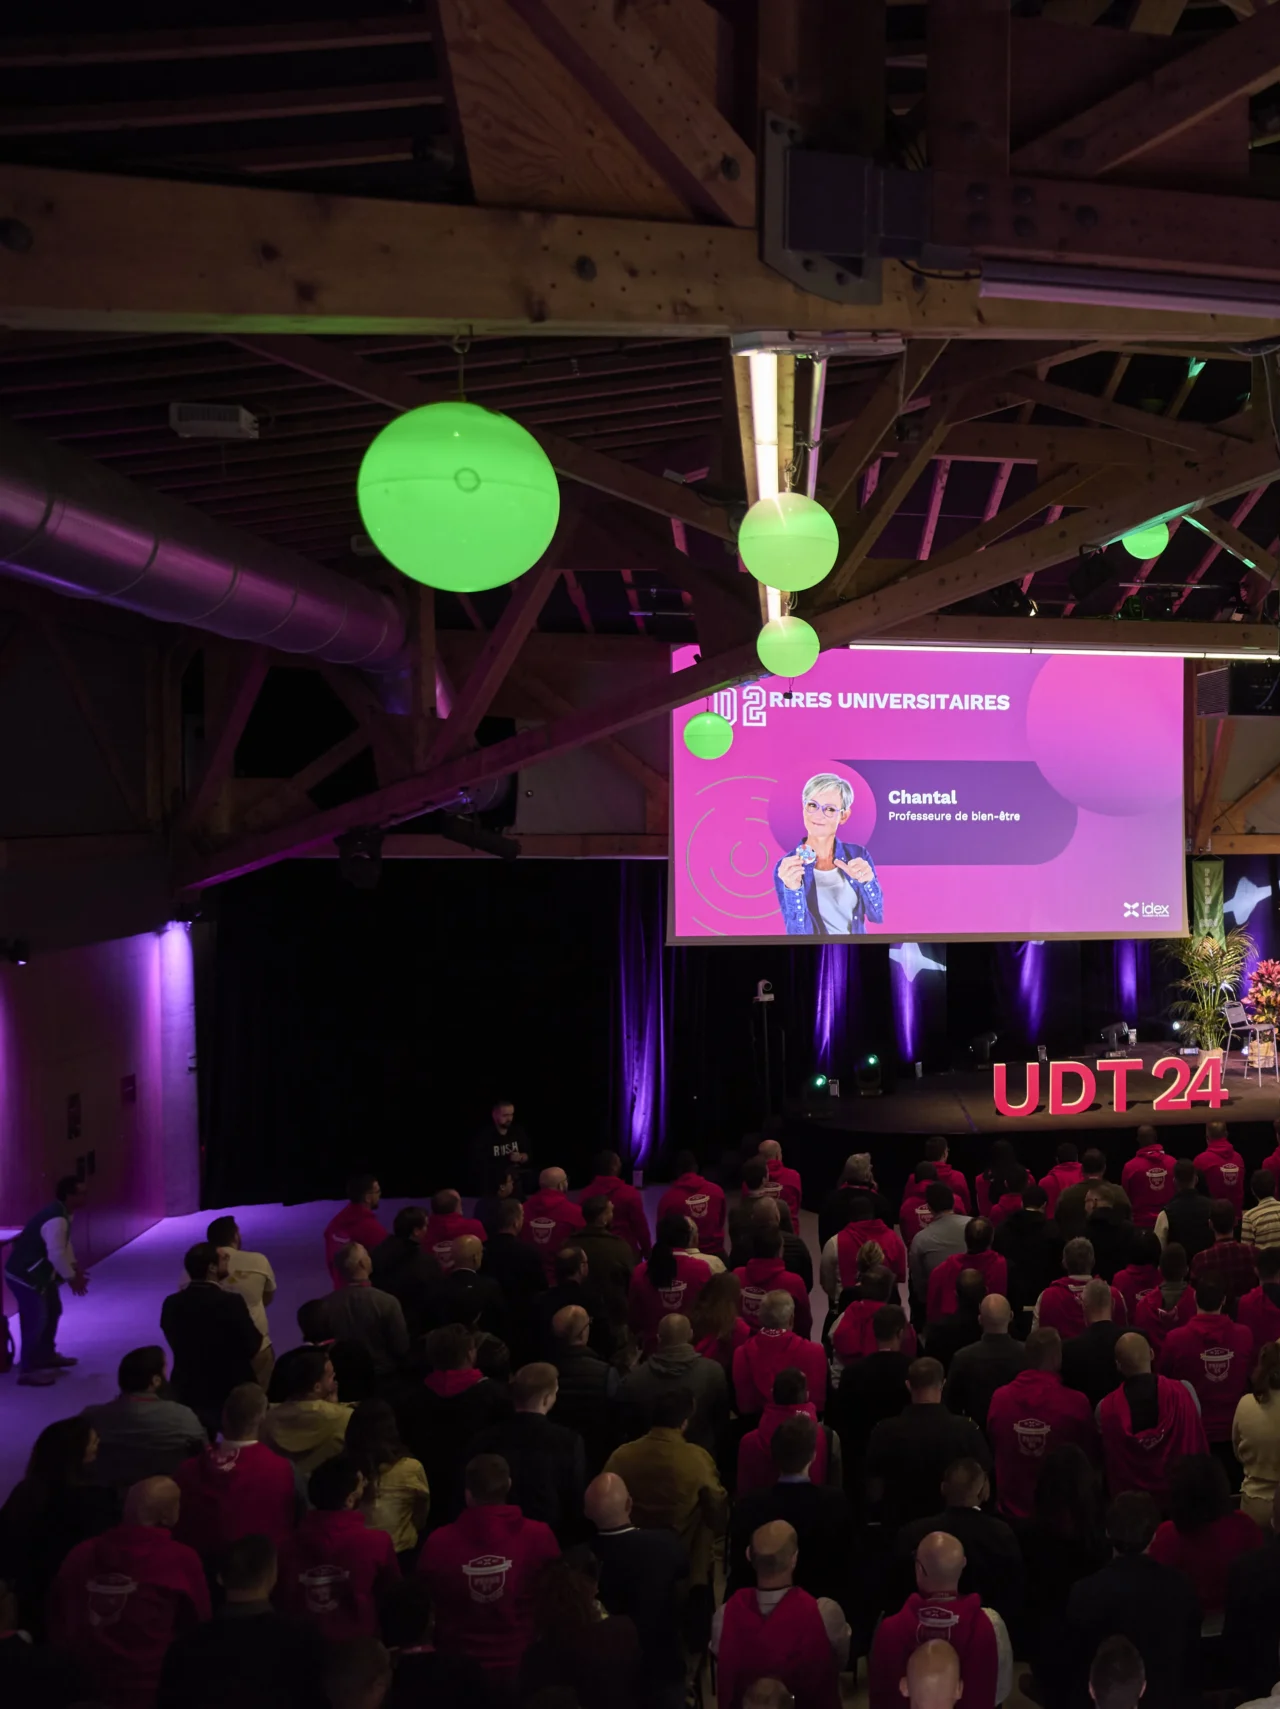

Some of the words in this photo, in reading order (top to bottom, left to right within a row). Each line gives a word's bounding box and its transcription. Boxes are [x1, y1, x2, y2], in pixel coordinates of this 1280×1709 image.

[769, 691, 832, 709] RIRES
[837, 692, 1011, 710] UNIVERSITAIRES
[888, 789, 958, 805] Chantal
[888, 811, 953, 822] Professeure
[955, 811, 969, 822] de
[971, 811, 1021, 823] bien-être
[1142, 902, 1169, 915] idex
[993, 1058, 1143, 1117] UDT
[1151, 1056, 1229, 1111] 24
